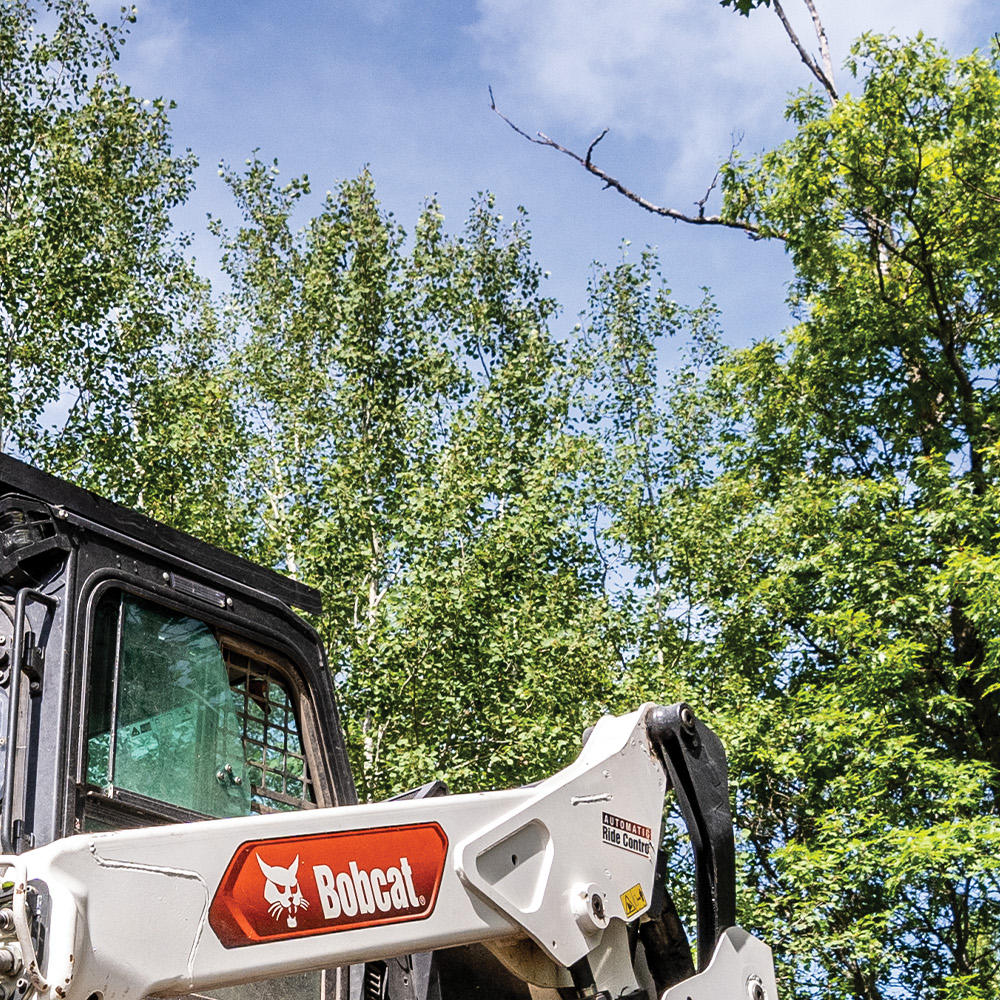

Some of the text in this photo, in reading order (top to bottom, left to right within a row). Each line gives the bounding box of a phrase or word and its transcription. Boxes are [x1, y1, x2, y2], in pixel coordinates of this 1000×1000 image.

[602, 825, 621, 844] Ride
[603, 814, 651, 839] AUTOMATIC
[313, 857, 420, 919] Bobcat
